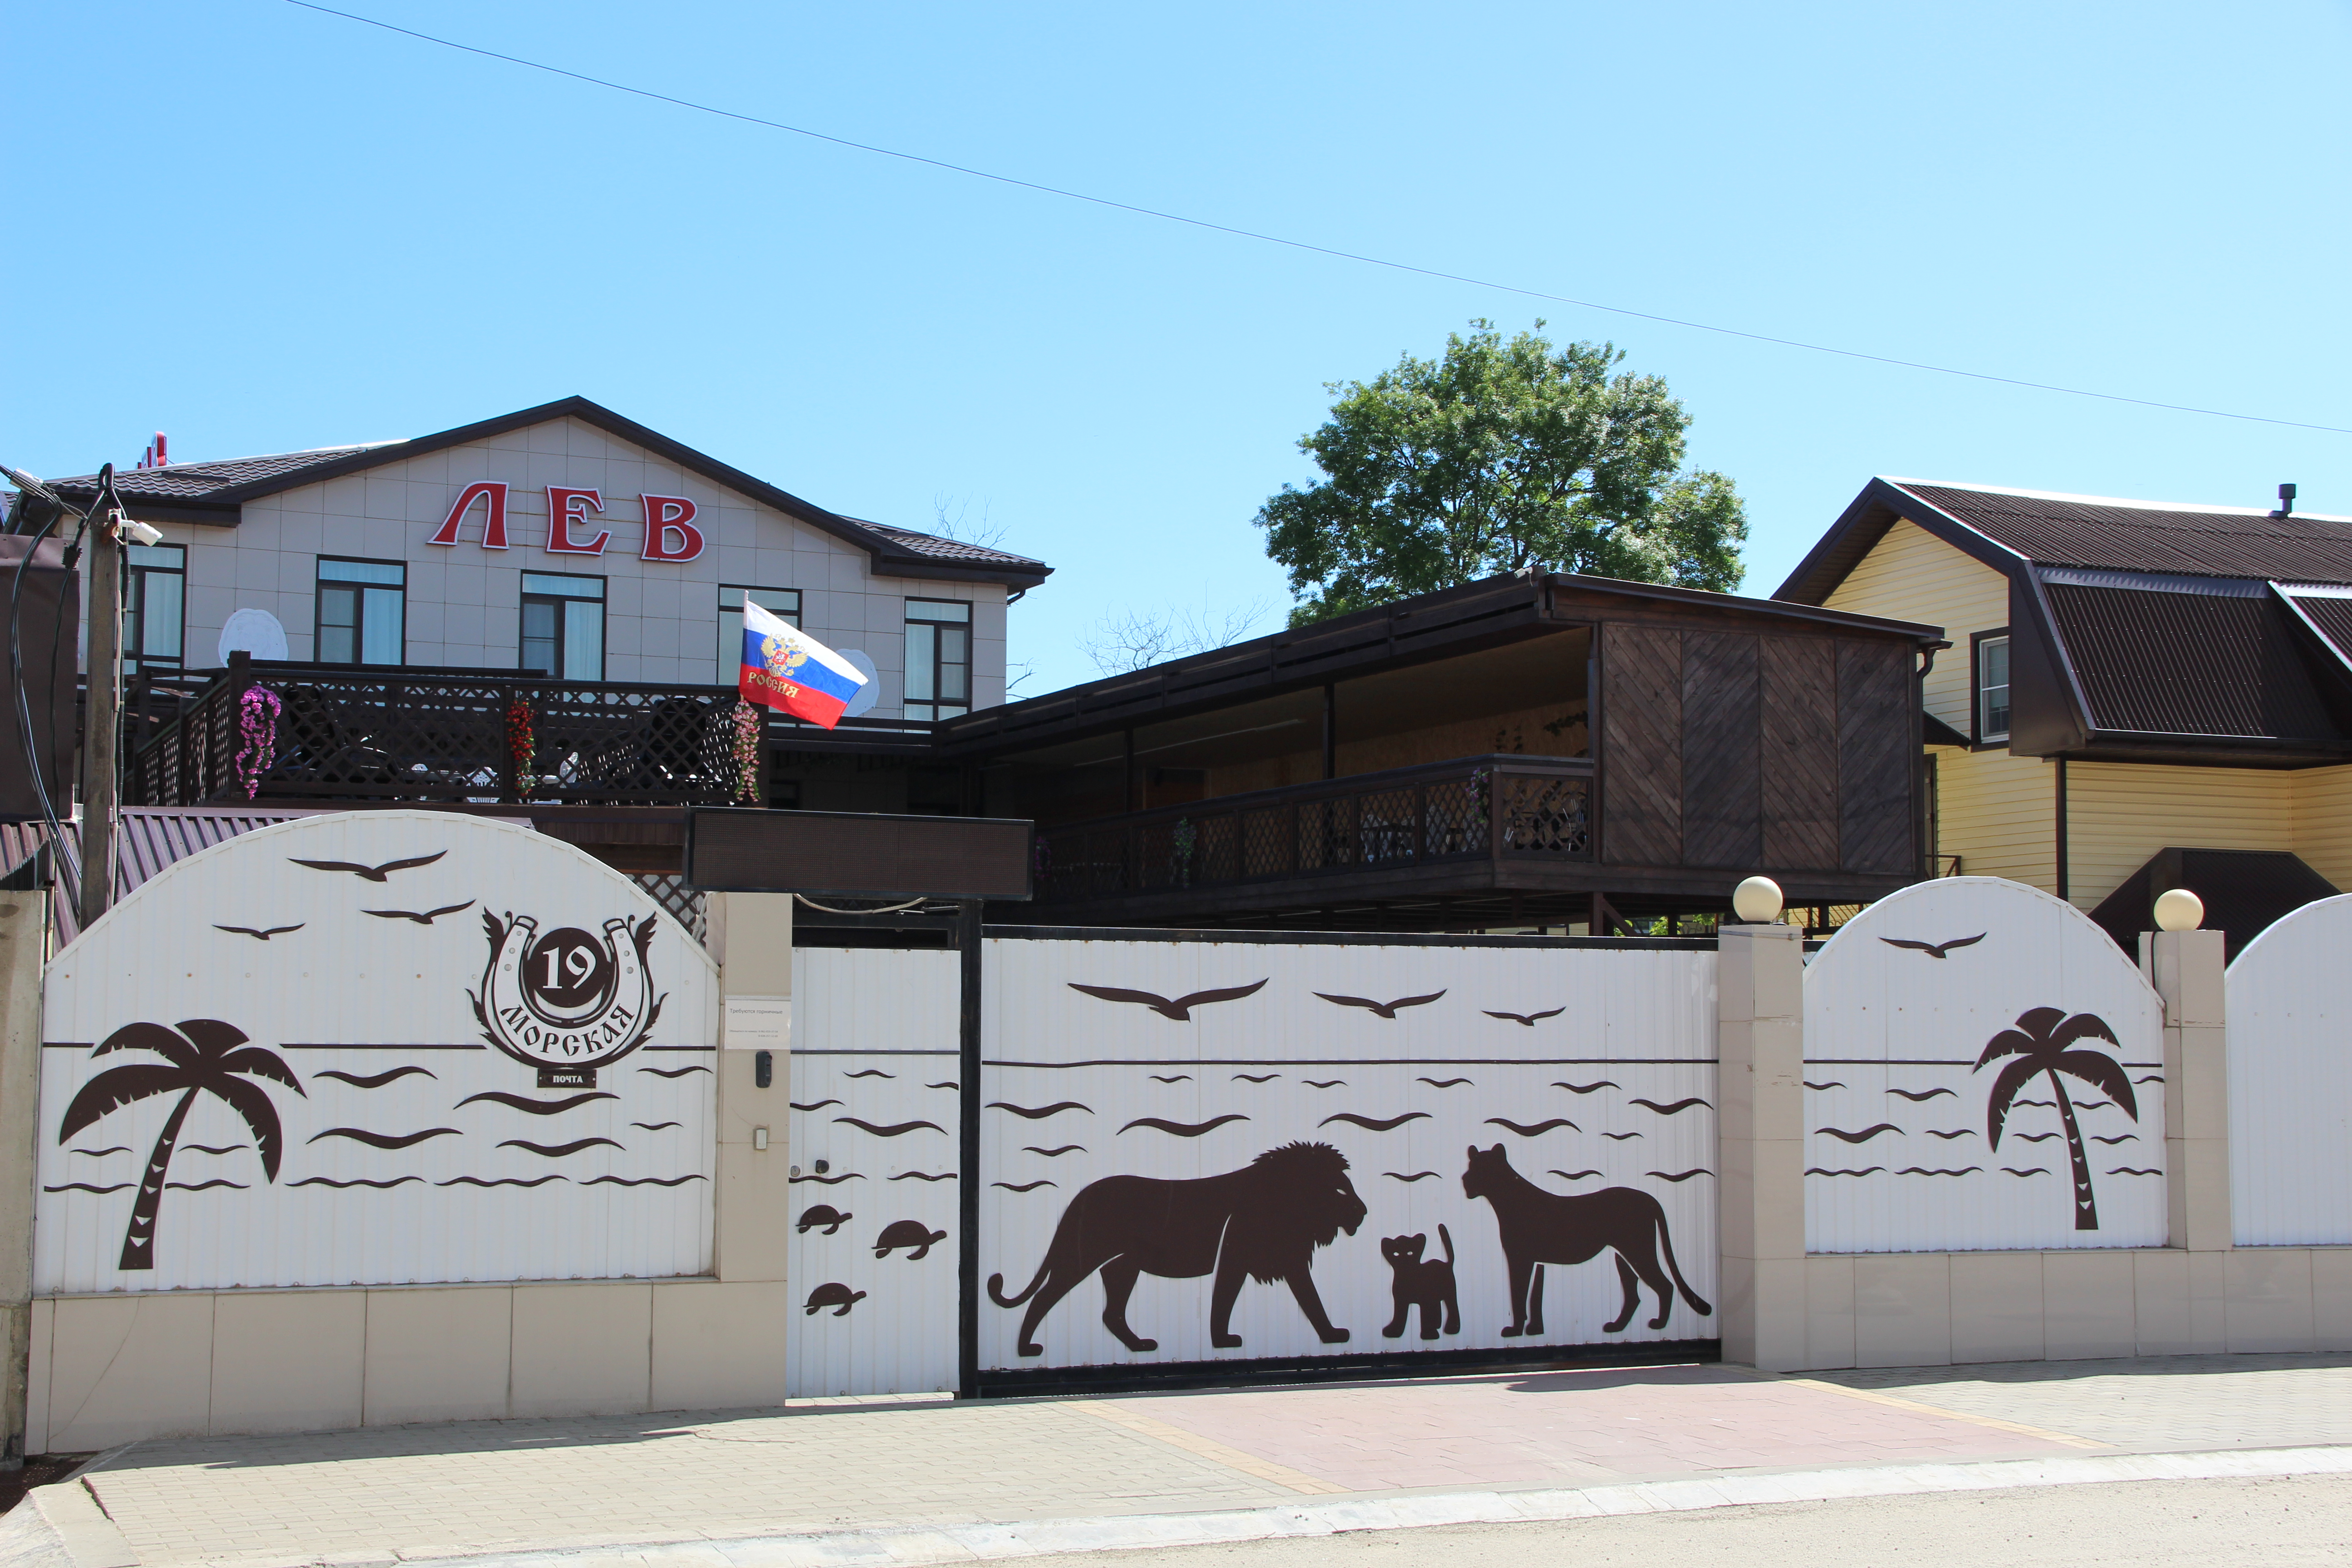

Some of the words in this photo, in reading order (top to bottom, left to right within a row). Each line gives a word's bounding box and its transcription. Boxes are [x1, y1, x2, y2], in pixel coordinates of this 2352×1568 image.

[427, 480, 706, 563] ЛЕВ
[747, 671, 800, 698] РОССИЯ
[542, 945, 597, 990] 19
[500, 1003, 635, 1057] МОРСКАЯ
[553, 1075, 583, 1083] ПОЧТА
